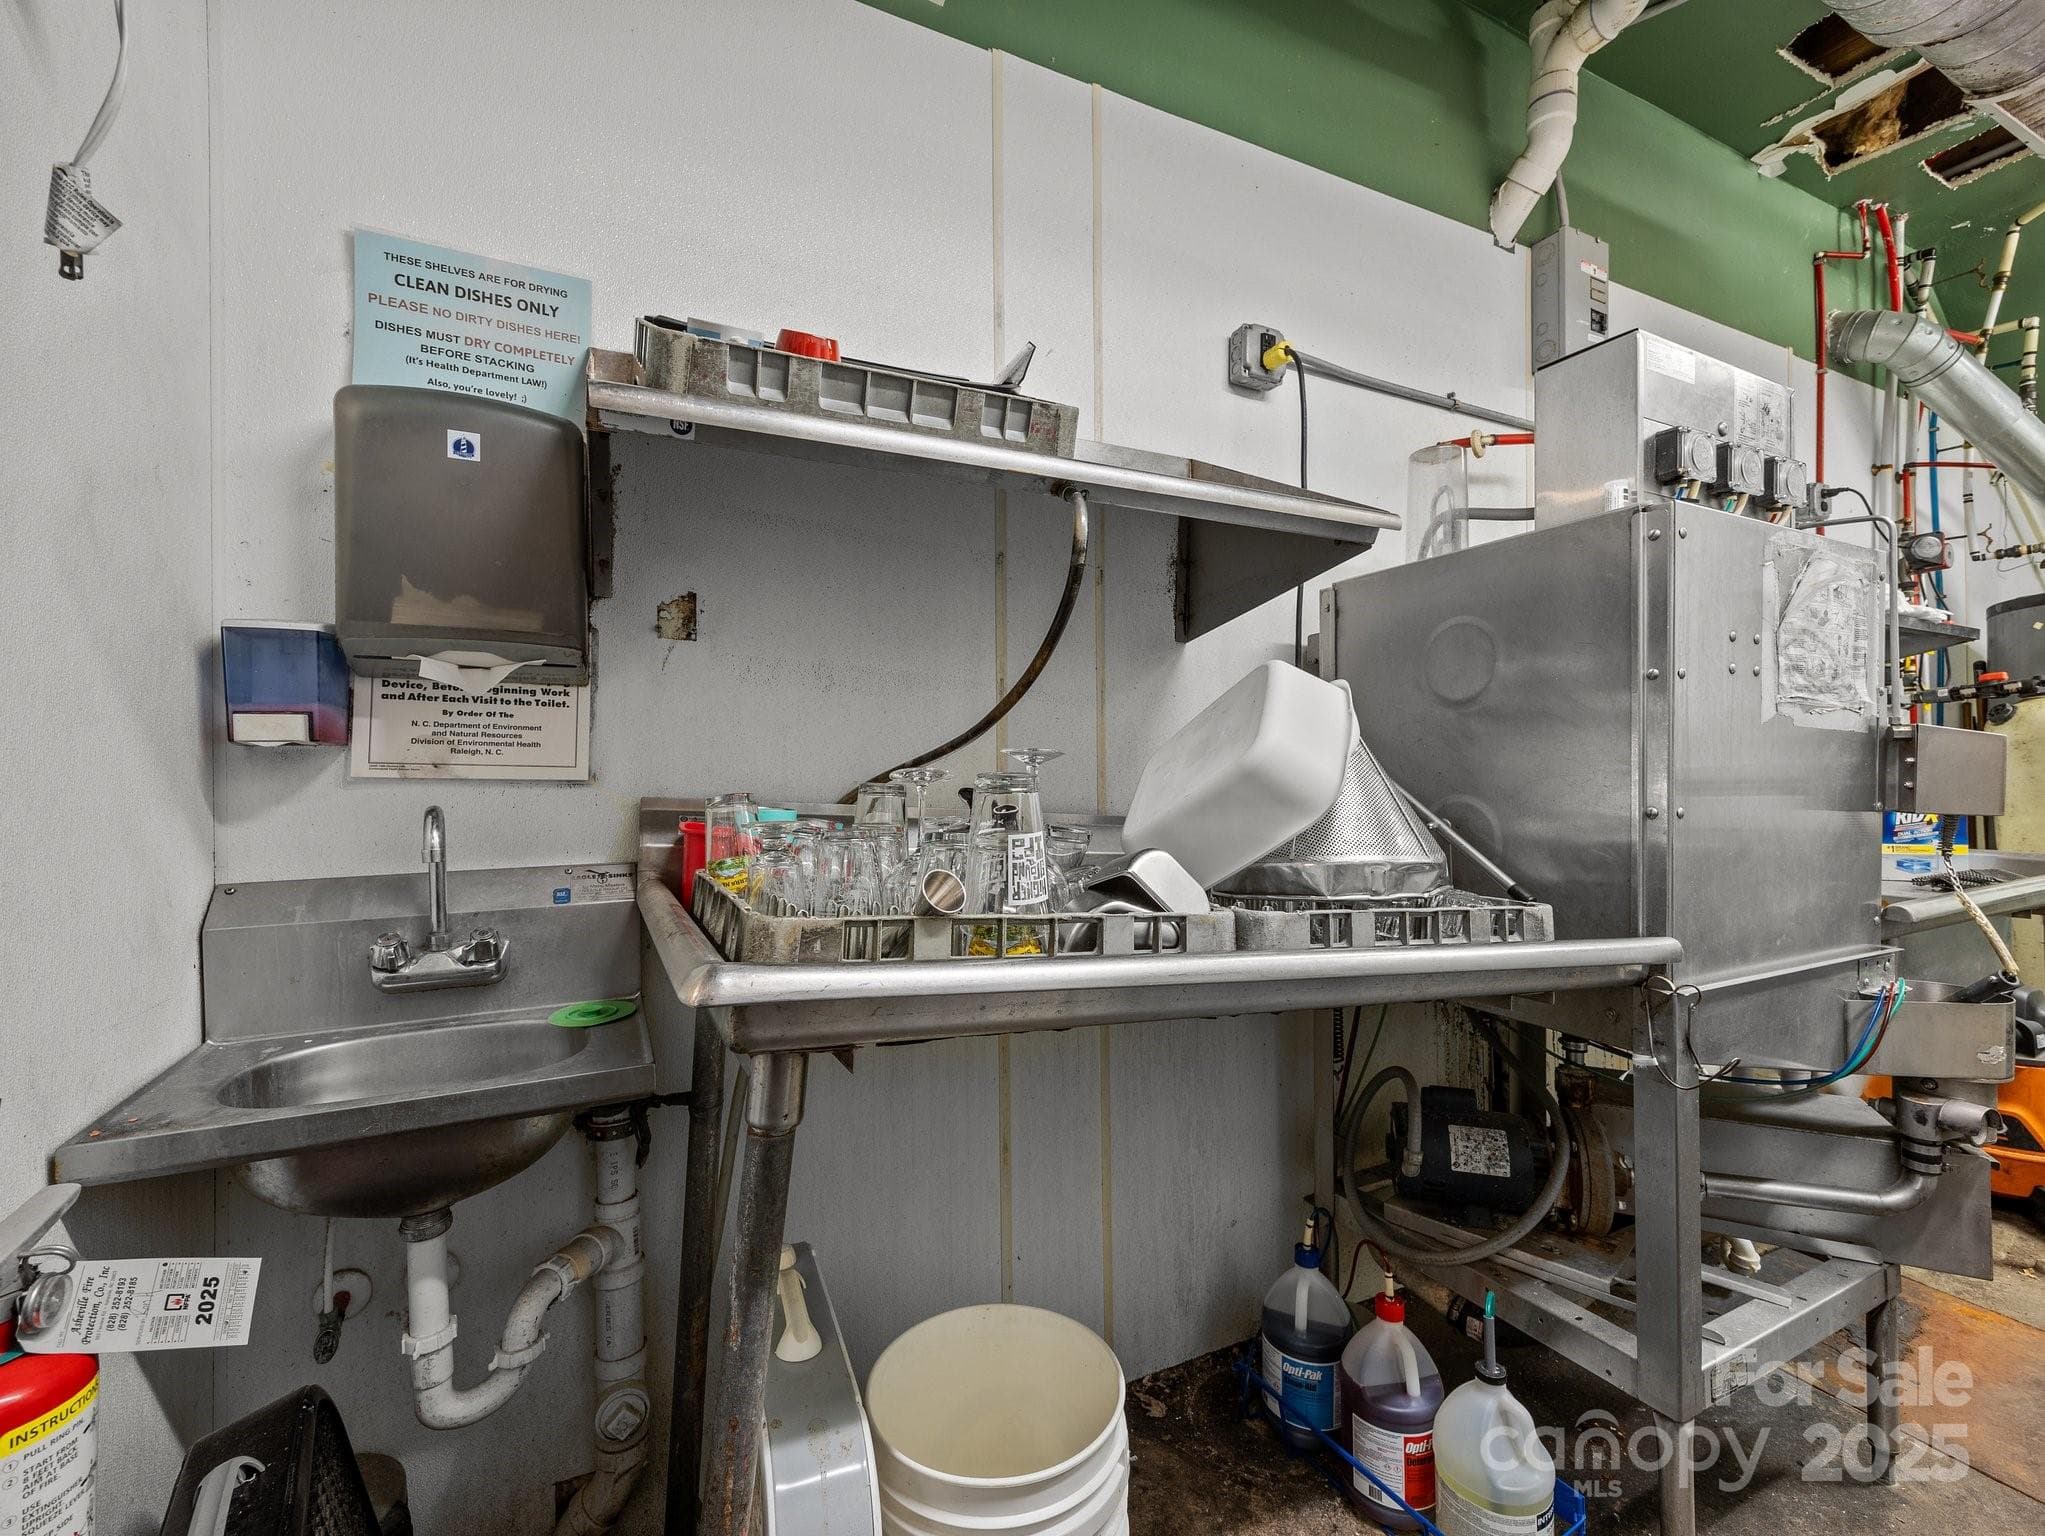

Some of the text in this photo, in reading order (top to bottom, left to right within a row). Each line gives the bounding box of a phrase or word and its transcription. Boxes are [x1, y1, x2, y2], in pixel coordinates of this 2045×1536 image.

[383, 252, 568, 298] THESE SHELVES ARE FOR DRYING
[394, 274, 559, 317] CLEAN DISHES ONLY
[368, 293, 581, 344] PLEASE NO DIRTY DISHES HERE!
[375, 320, 575, 366] DISHES MUST DRY COMPLETELY
[420, 344, 535, 373] BEFORE STACKING
[426, 360, 459, 373] Health
[462, 366, 519, 383] Department
[521, 377, 548, 390] LAW!)
[427, 377, 451, 390] Also,
[453, 383, 483, 395] you're
[486, 387, 517, 401] lovely!
[381, 680, 427, 691] Device,
[432, 682, 464, 692] Befo
[540, 687, 570, 697] Work
[381, 692, 570, 709] and After Each Visit to the Toilet.
[433, 721, 480, 730] Department
[493, 723, 542, 731] Environment
[442, 709, 453, 717] By
[456, 710, 483, 718] Order
[499, 711, 514, 719] The
[449, 730, 478, 738] Natural
[450, 748, 483, 756] Raleigh,
[71, 1276, 95, 1336] Asheville Fire
[81, 1301, 103, 1345] Protection,
[98, 1265, 111, 1279] Inc
[111, 1277, 127, 1310] 252-8193
[117, 1276, 138, 1331] (828) 252-8185
[182, 1294, 192, 1310] NFPA
[195, 1276, 220, 1326] 2025
[106, 1313, 118, 1332] (828)
[1283, 1362, 1323, 1382] Opti-Pak
[23, 1444, 47, 1461] PULL
[23, 1454, 54, 1477] START
[56, 1437, 78, 1457] FROM
[32, 1462, 54, 1479] FEET
[57, 1447, 78, 1464] BACK
[22, 1452, 78, 1493] AIM AT BASE
[22, 1488, 36, 1500] OF
[22, 1499, 41, 1515] USE
[22, 1500, 63, 1531] UPRIGHT
